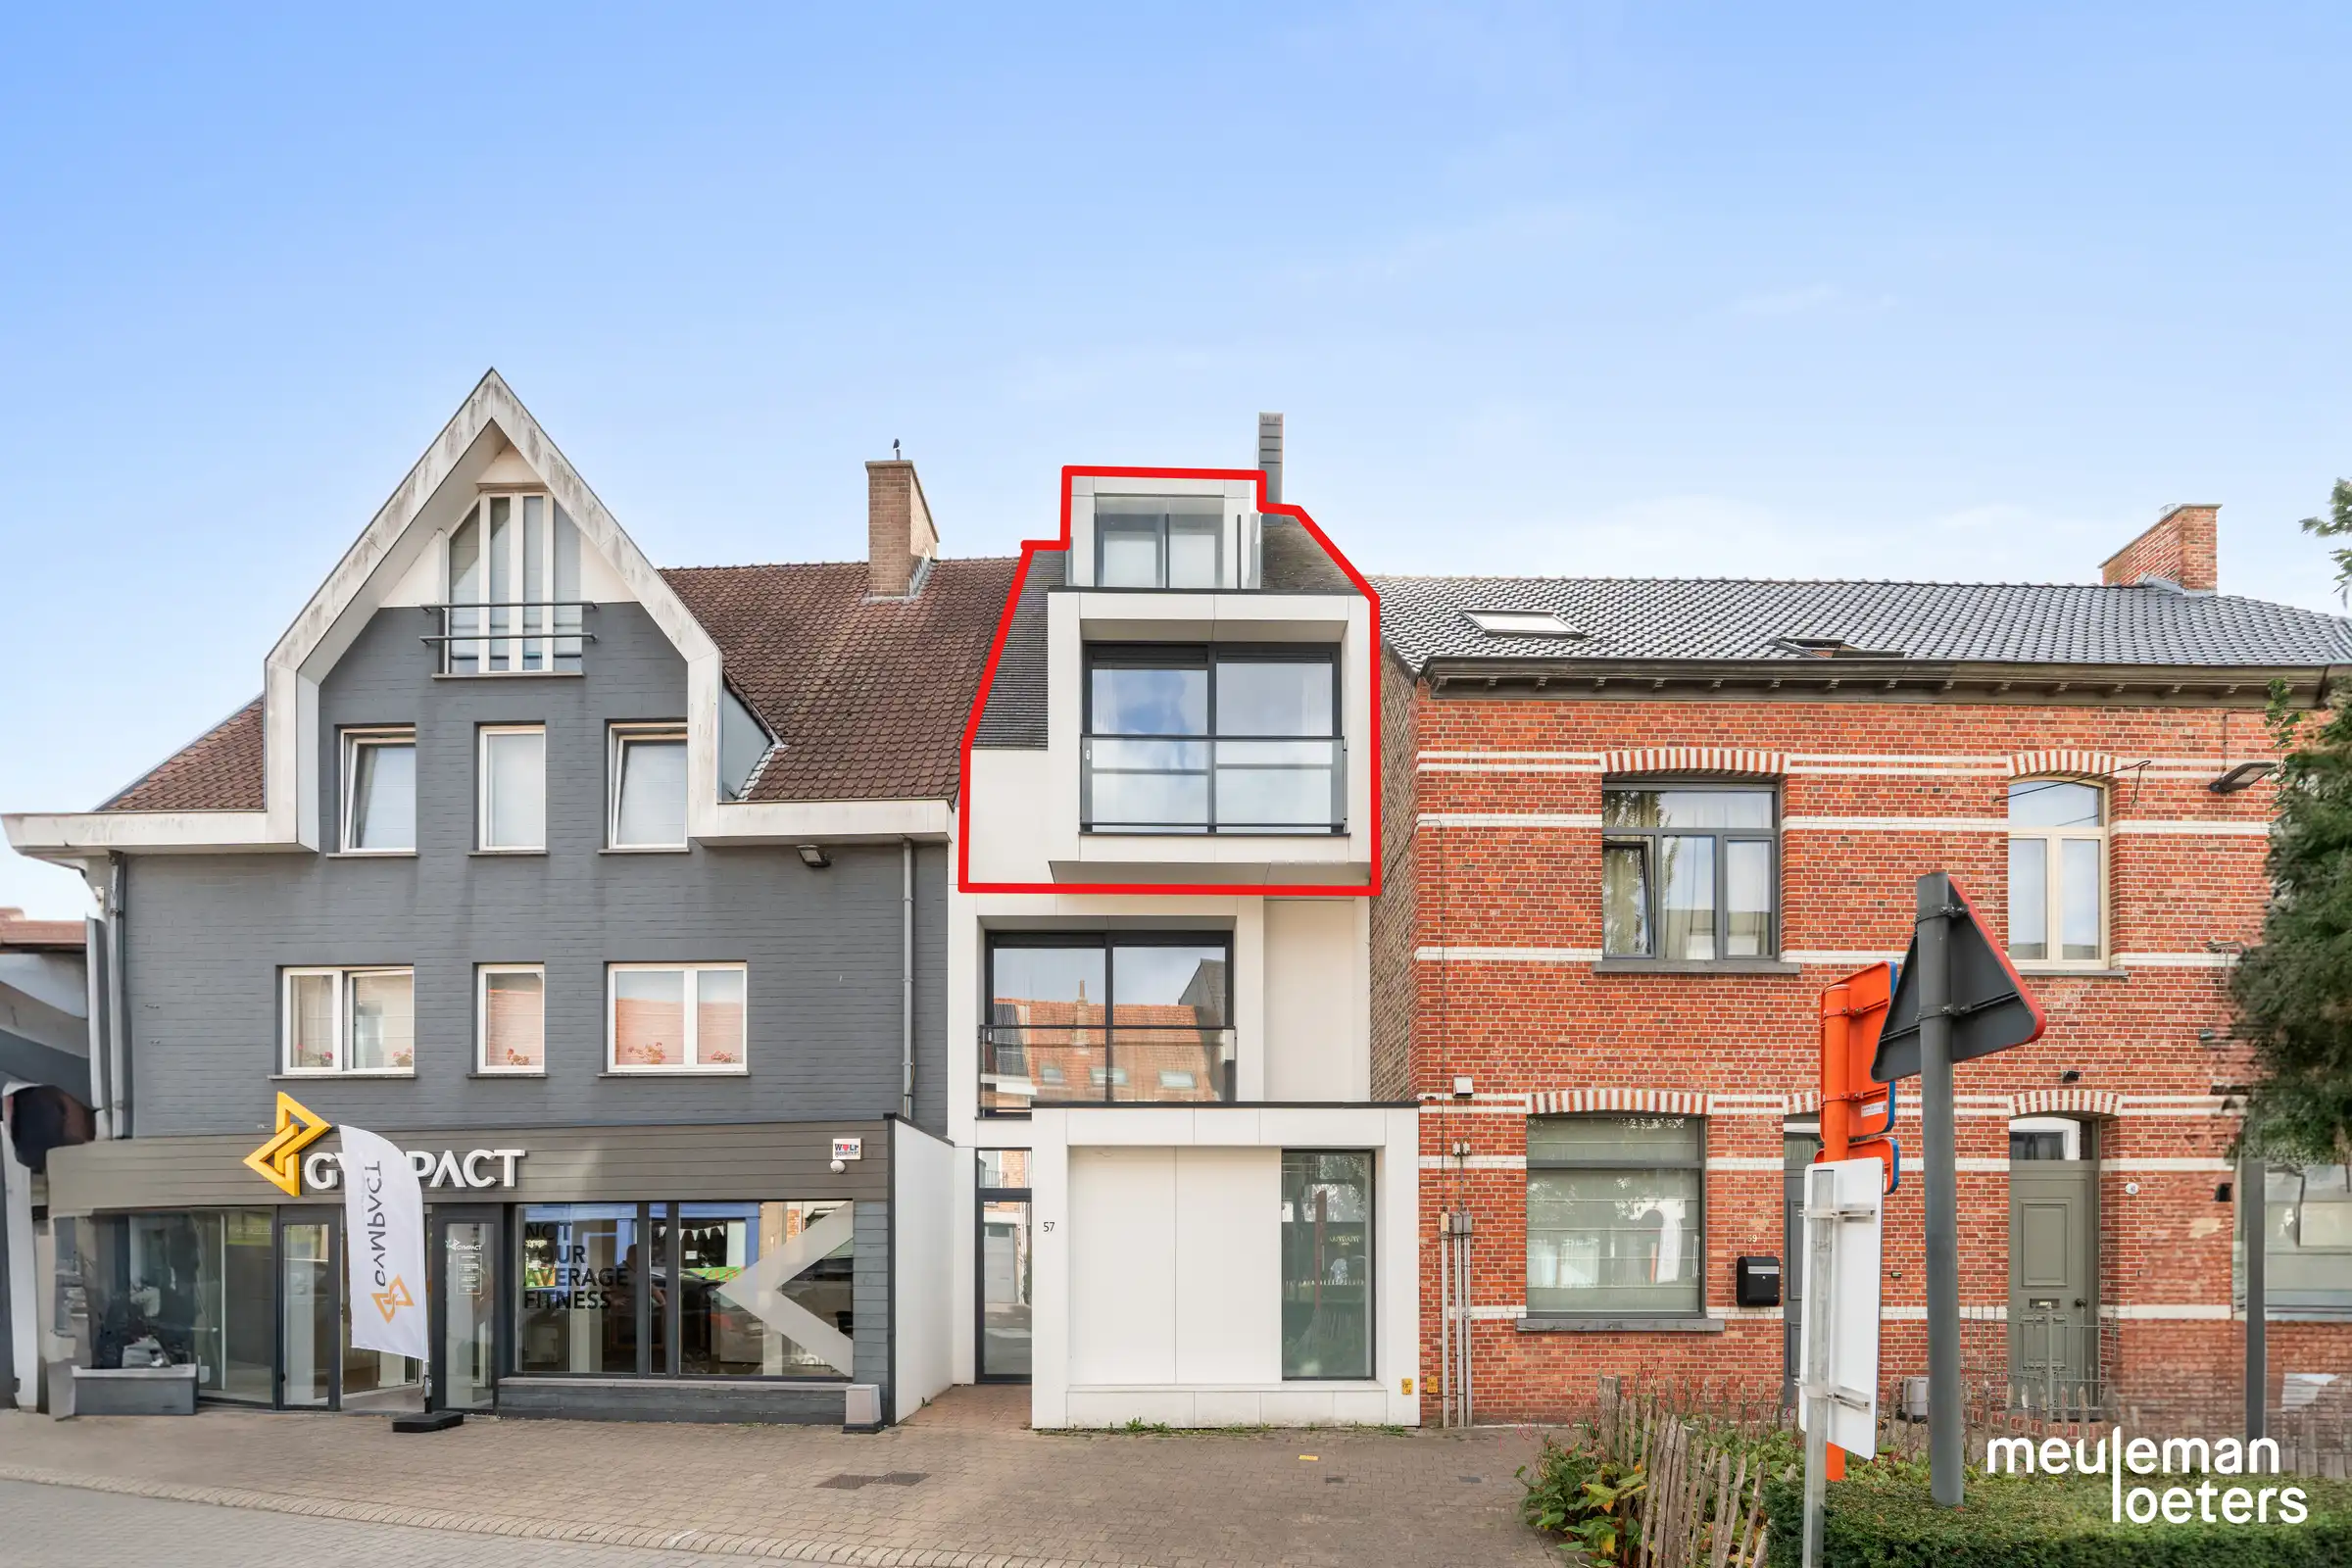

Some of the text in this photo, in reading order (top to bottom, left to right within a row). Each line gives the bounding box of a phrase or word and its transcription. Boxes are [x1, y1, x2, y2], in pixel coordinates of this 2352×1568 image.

[304, 1150, 525, 1190] GPACT
[525, 1222, 571, 1241] NOT
[1044, 1222, 1054, 1232] 57
[524, 1246, 586, 1263] OUR
[523, 1268, 628, 1286] AVERAGE
[524, 1291, 612, 1309] FITNESS
